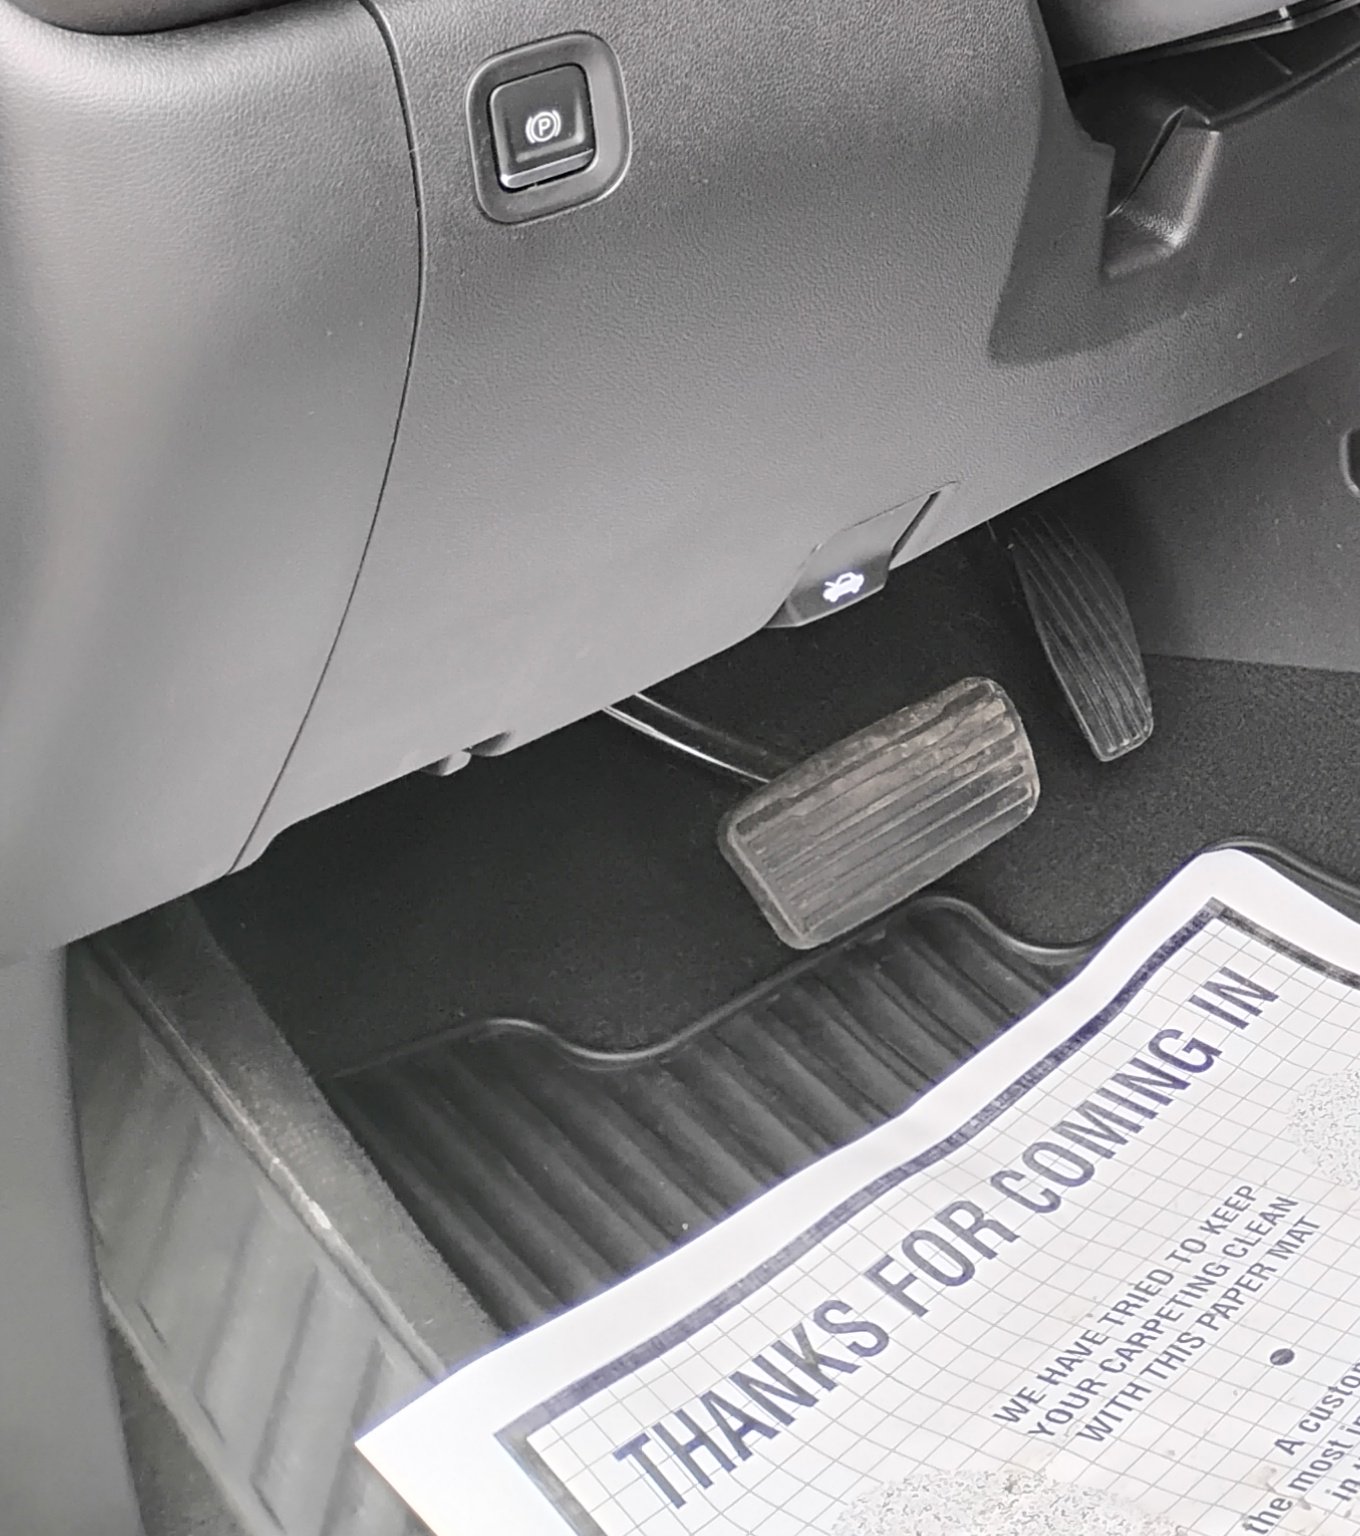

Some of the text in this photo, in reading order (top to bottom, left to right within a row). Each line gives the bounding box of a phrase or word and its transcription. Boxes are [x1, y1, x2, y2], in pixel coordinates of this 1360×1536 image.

[612, 966, 1279, 1509] THANKS FOR COMING IN
[992, 1185, 1258, 1425] WE HAVE TRIED TO KEEP
[1028, 1196, 1299, 1437] YOUR CARPETING CLEAN
[1076, 1215, 1320, 1443] WITH THIS PAPER MAT
[1242, 1496, 1293, 1536] the
[1287, 1439, 1353, 1492] most
[1274, 1438, 1306, 1456] A
[1324, 1477, 1356, 1503] in
